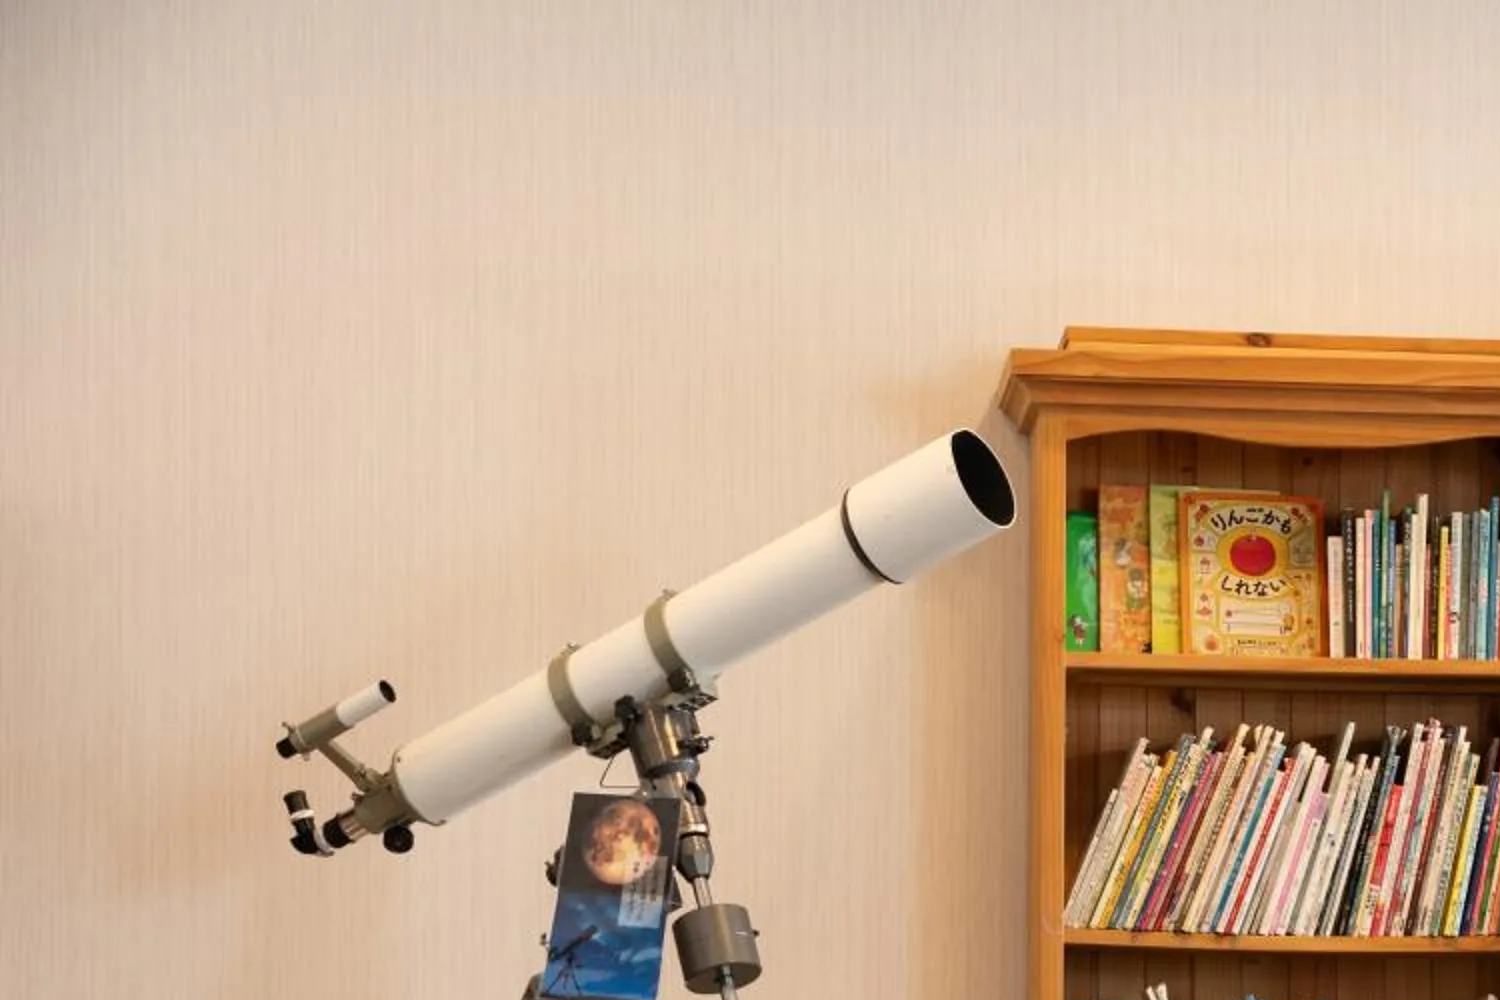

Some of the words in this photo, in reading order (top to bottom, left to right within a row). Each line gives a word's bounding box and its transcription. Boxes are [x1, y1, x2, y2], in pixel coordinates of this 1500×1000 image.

[1210, 508, 1291, 534] りんごかも
[1221, 575, 1286, 597] しれない
